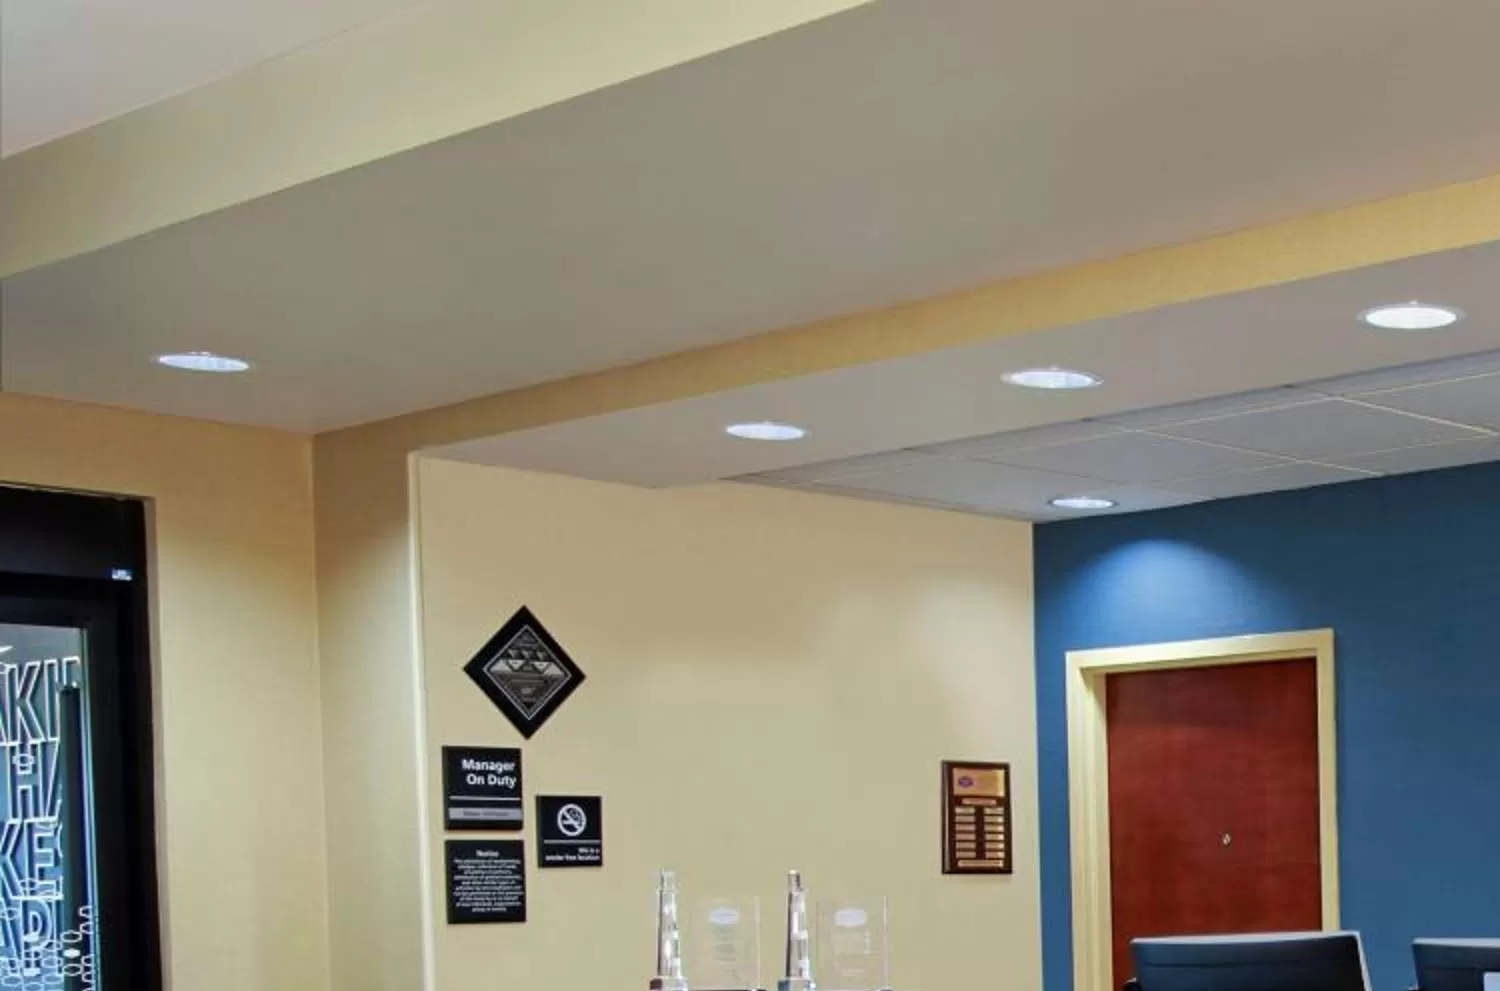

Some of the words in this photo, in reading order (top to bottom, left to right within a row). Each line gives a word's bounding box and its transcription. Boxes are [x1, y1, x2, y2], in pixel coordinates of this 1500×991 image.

[461, 758, 516, 774] Manager
[466, 773, 485, 786] On
[487, 774, 517, 789] Duty
